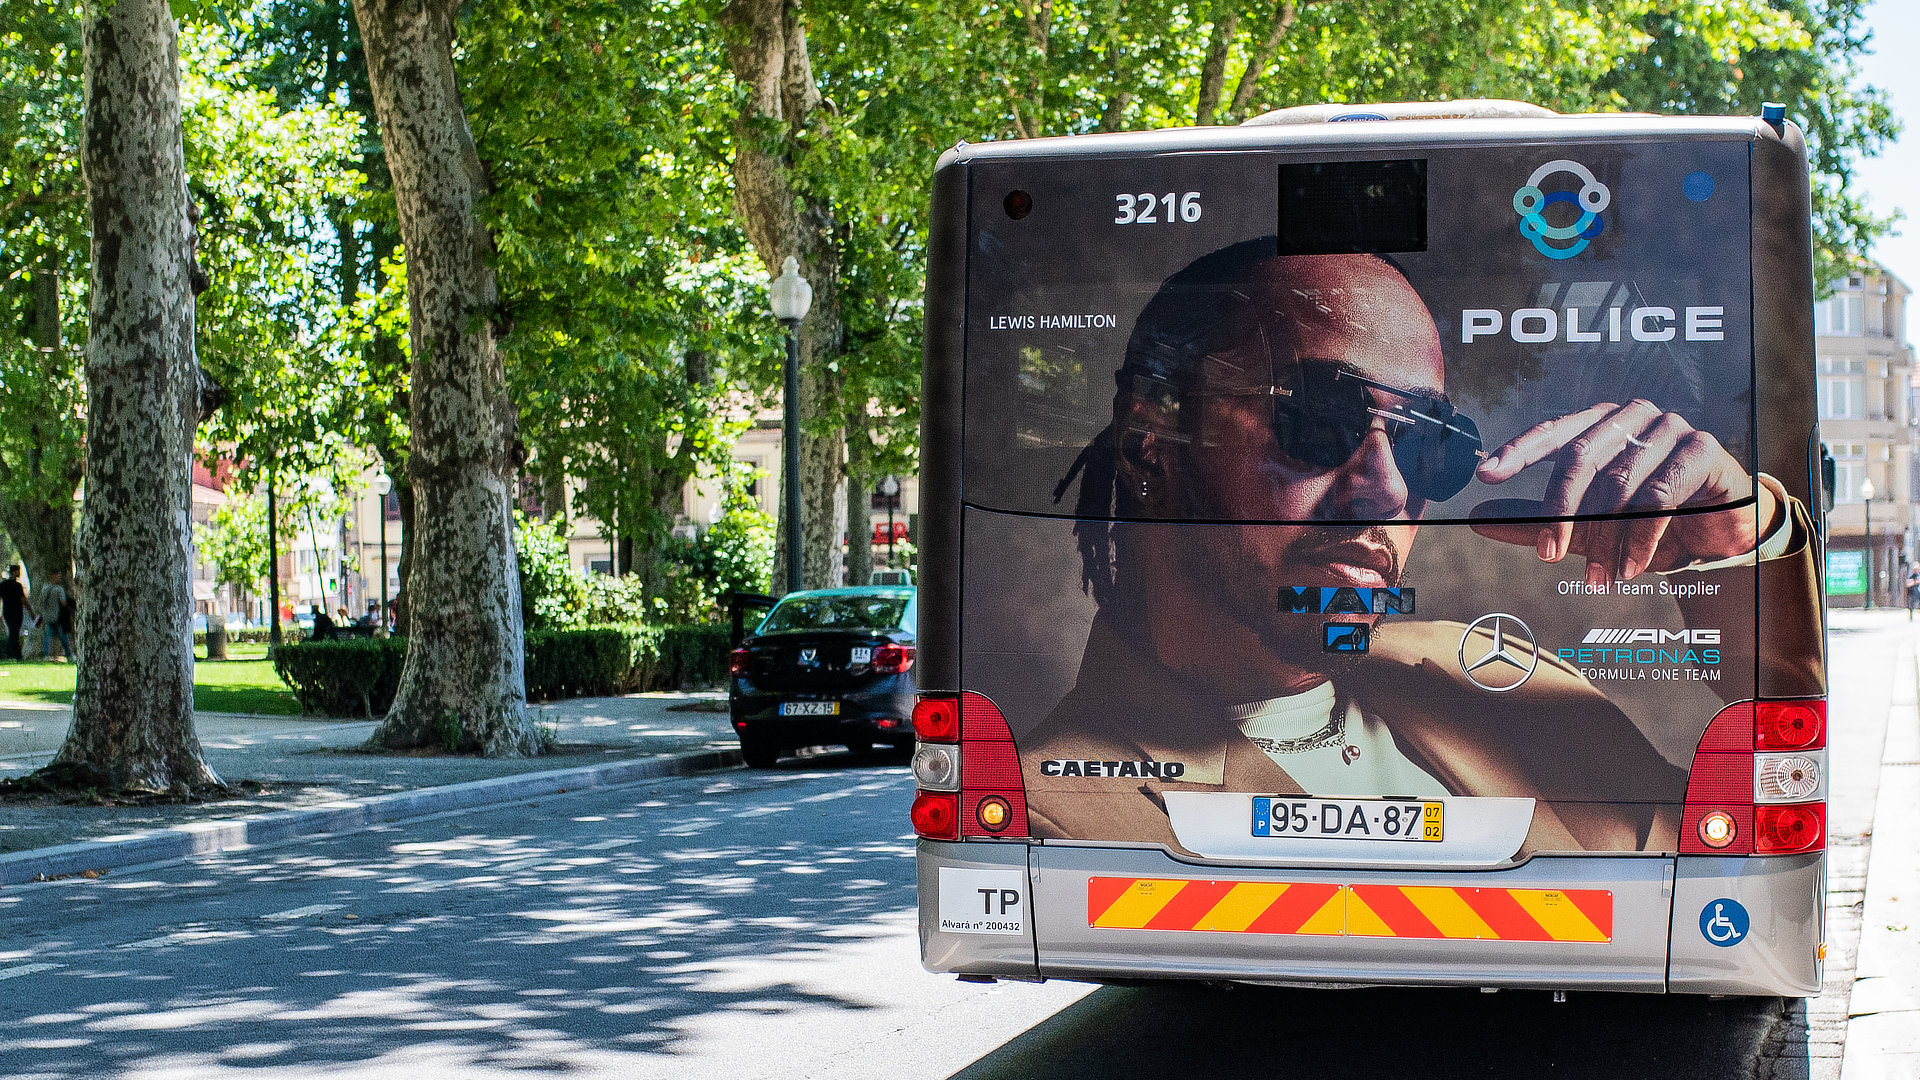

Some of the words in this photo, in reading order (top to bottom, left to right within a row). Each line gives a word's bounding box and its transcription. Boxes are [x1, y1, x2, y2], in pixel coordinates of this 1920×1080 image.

[1115, 192, 1202, 224] 3216
[990, 315, 1035, 330] LEWIS
[1040, 314, 1116, 329] HAMILTON
[1461, 306, 1724, 344] POLICE
[1557, 581, 1610, 595] Official
[1615, 581, 1654, 595] Team
[1659, 581, 1721, 599] Supplier
[1278, 587, 1415, 614] MAN
[1624, 629, 1721, 644] AMG
[1558, 648, 1721, 664] PETRONAS
[1580, 668, 1646, 681] FORMULA
[1651, 669, 1679, 681] ONE
[1685, 669, 1721, 681] TEAM
[1040, 760, 1185, 778] CAETANO
[1425, 807, 1440, 818] 07
[1258, 820, 1266, 830] P
[1425, 826, 1440, 837] 02
[978, 888, 1020, 915] TP
[942, 919, 970, 930] Alvará
[986, 921, 1020, 931] 200432
